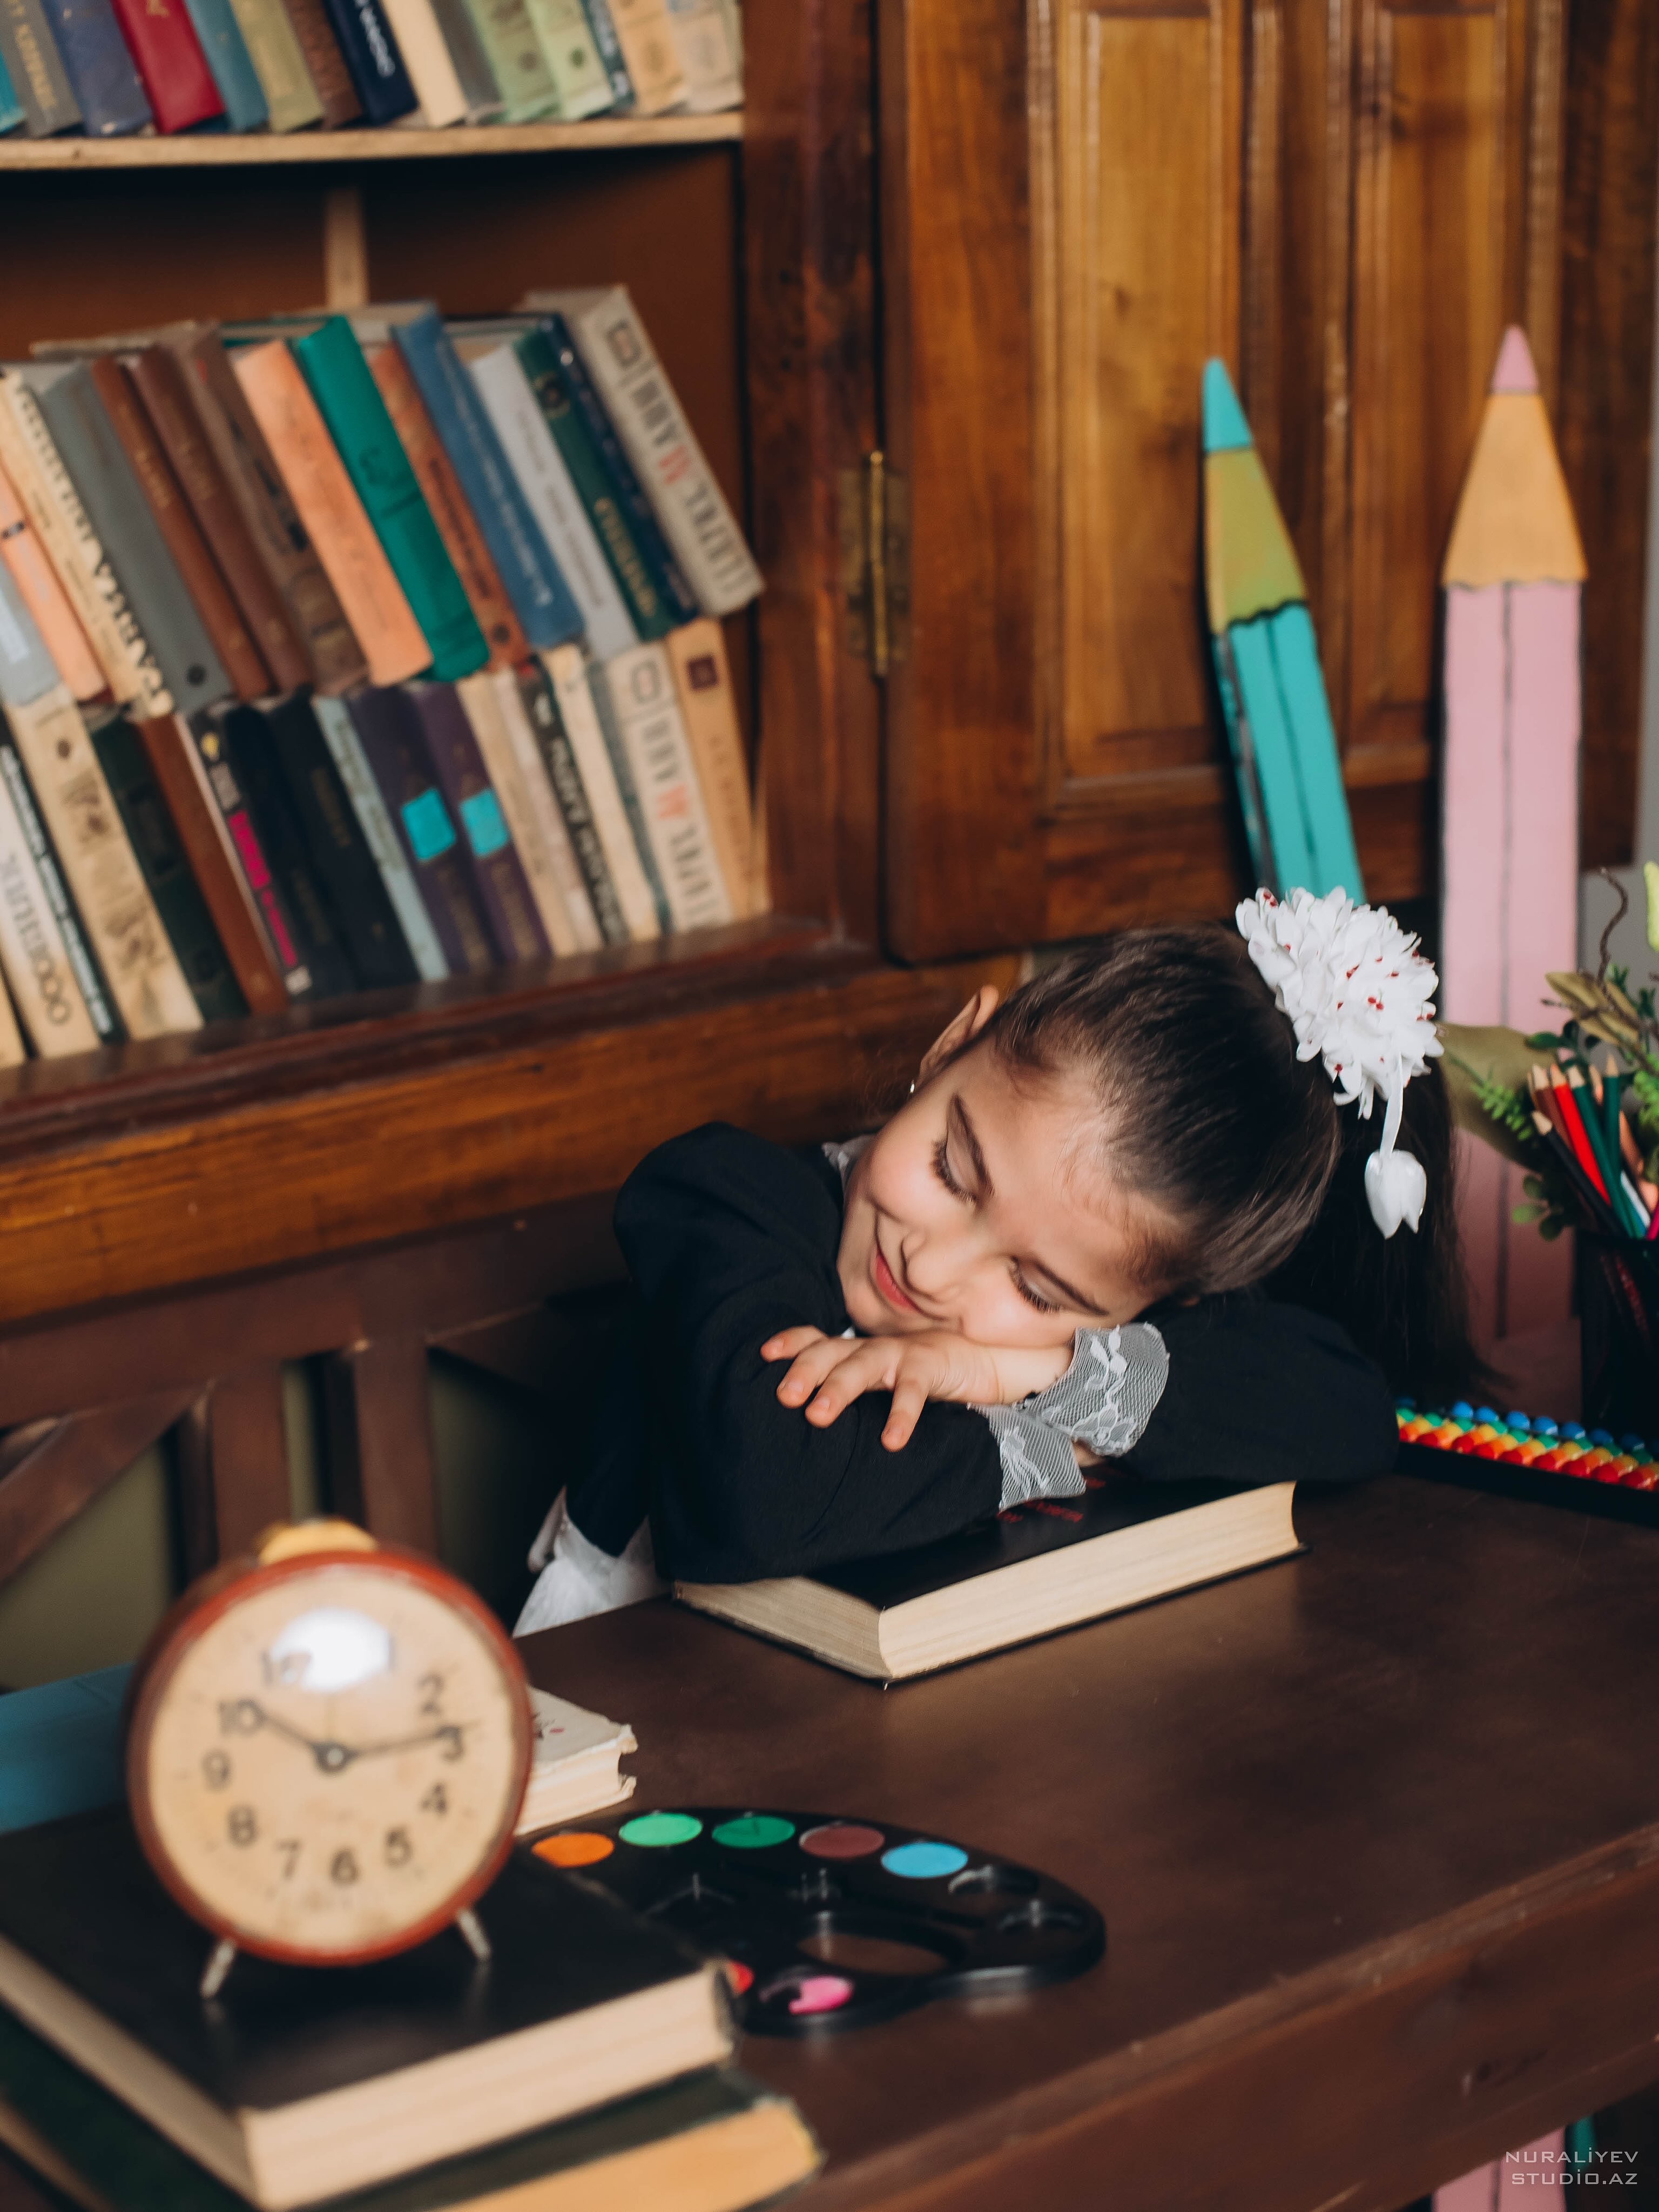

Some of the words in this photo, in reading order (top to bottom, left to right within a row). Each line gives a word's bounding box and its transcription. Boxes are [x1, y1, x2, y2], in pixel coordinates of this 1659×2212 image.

[417, 1671, 444, 1716] 2
[218, 1698, 264, 1737] 10
[436, 1723, 466, 1763] 3
[201, 1749, 232, 1792] 9
[419, 1782, 448, 1817] 4
[227, 1803, 258, 1848] 8
[276, 1839, 301, 1881] 7
[330, 1846, 360, 1886] 6
[386, 1827, 412, 1868] 5
